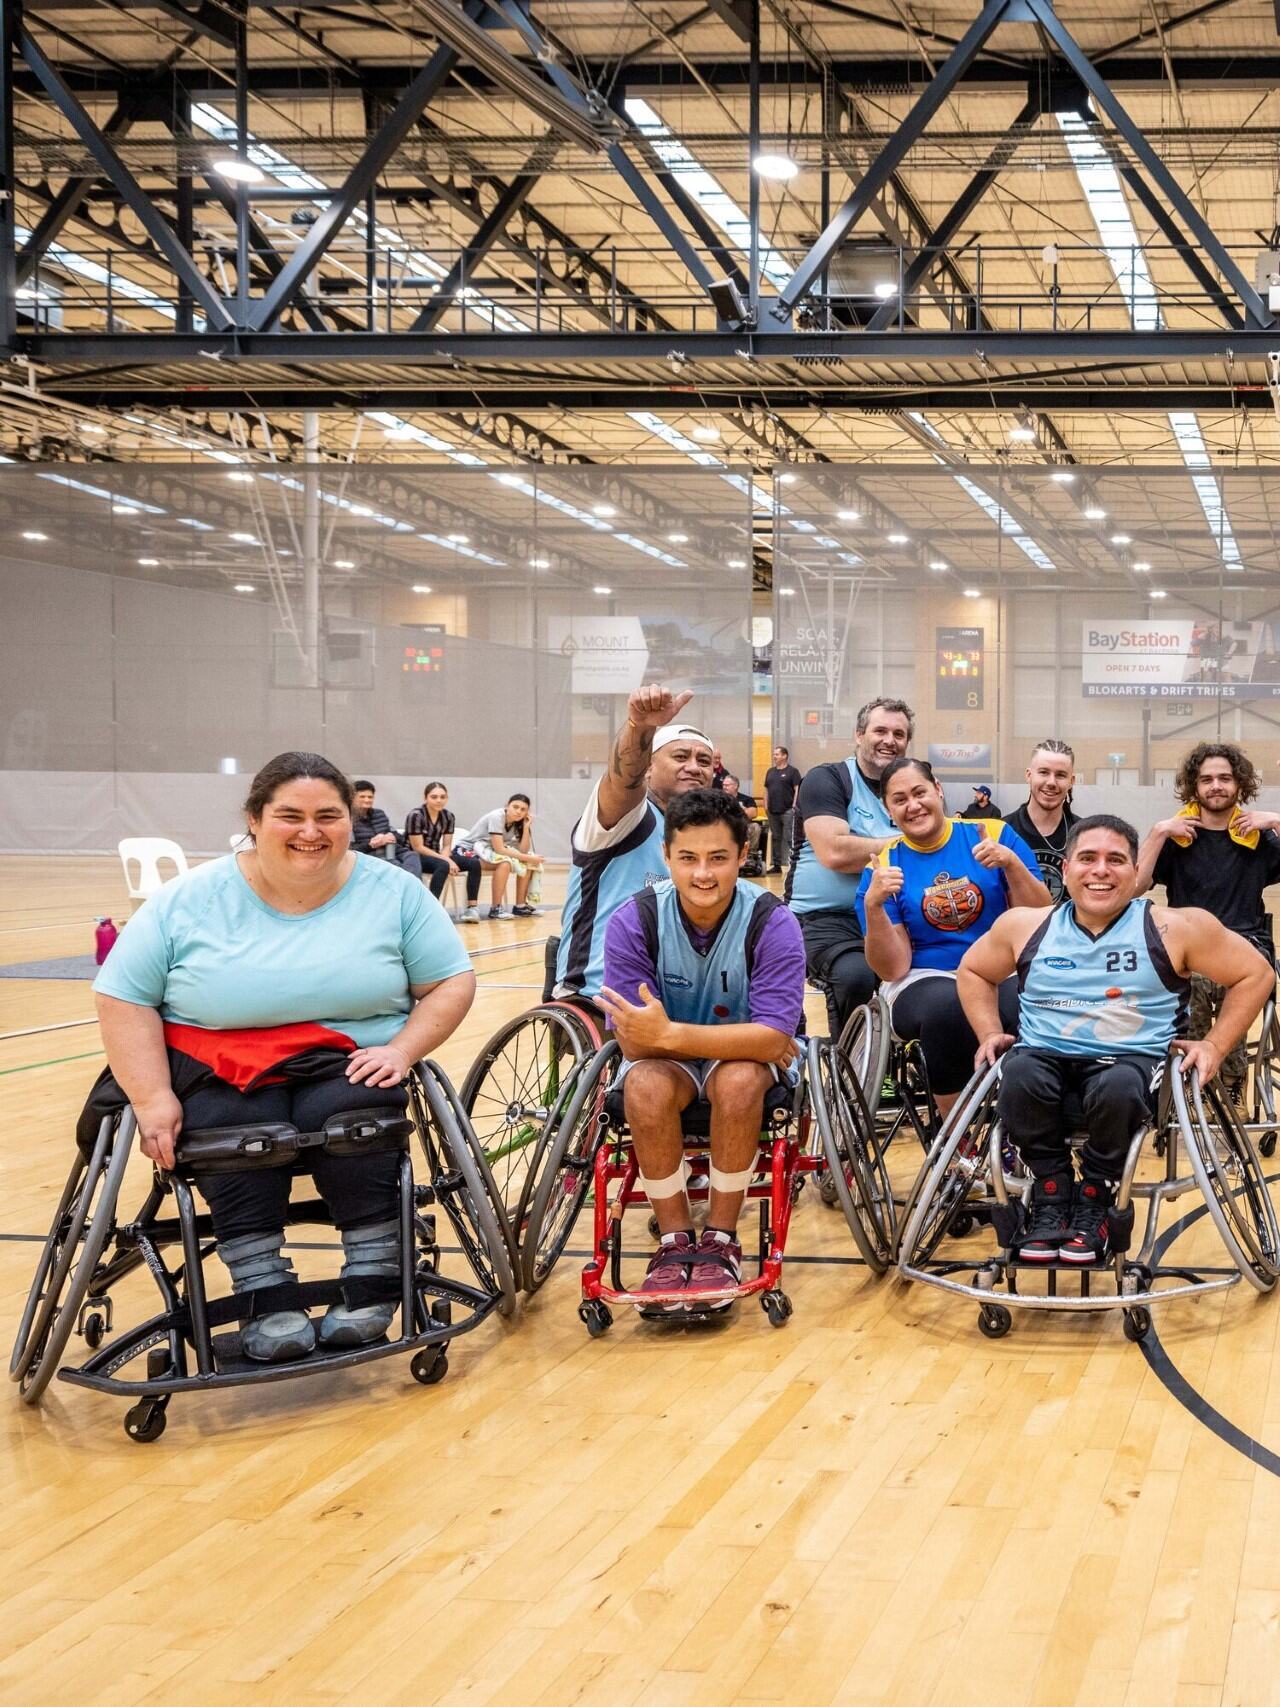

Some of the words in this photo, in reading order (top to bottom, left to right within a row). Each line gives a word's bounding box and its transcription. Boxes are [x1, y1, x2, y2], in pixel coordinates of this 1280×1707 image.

[582, 635, 629, 647] MOUNT
[1088, 630, 1180, 650] BayStation
[1106, 664, 1129, 672] OPEN
[1131, 664, 1137, 672] 7
[1138, 664, 1161, 672] DAYS
[1088, 685, 1146, 696] BLOKARTS
[1150, 686, 1158, 696] &
[1161, 685, 1194, 696] DRIFT
[967, 692, 978, 707] 8
[1106, 950, 1138, 973] 23
[720, 970, 728, 993] 1
